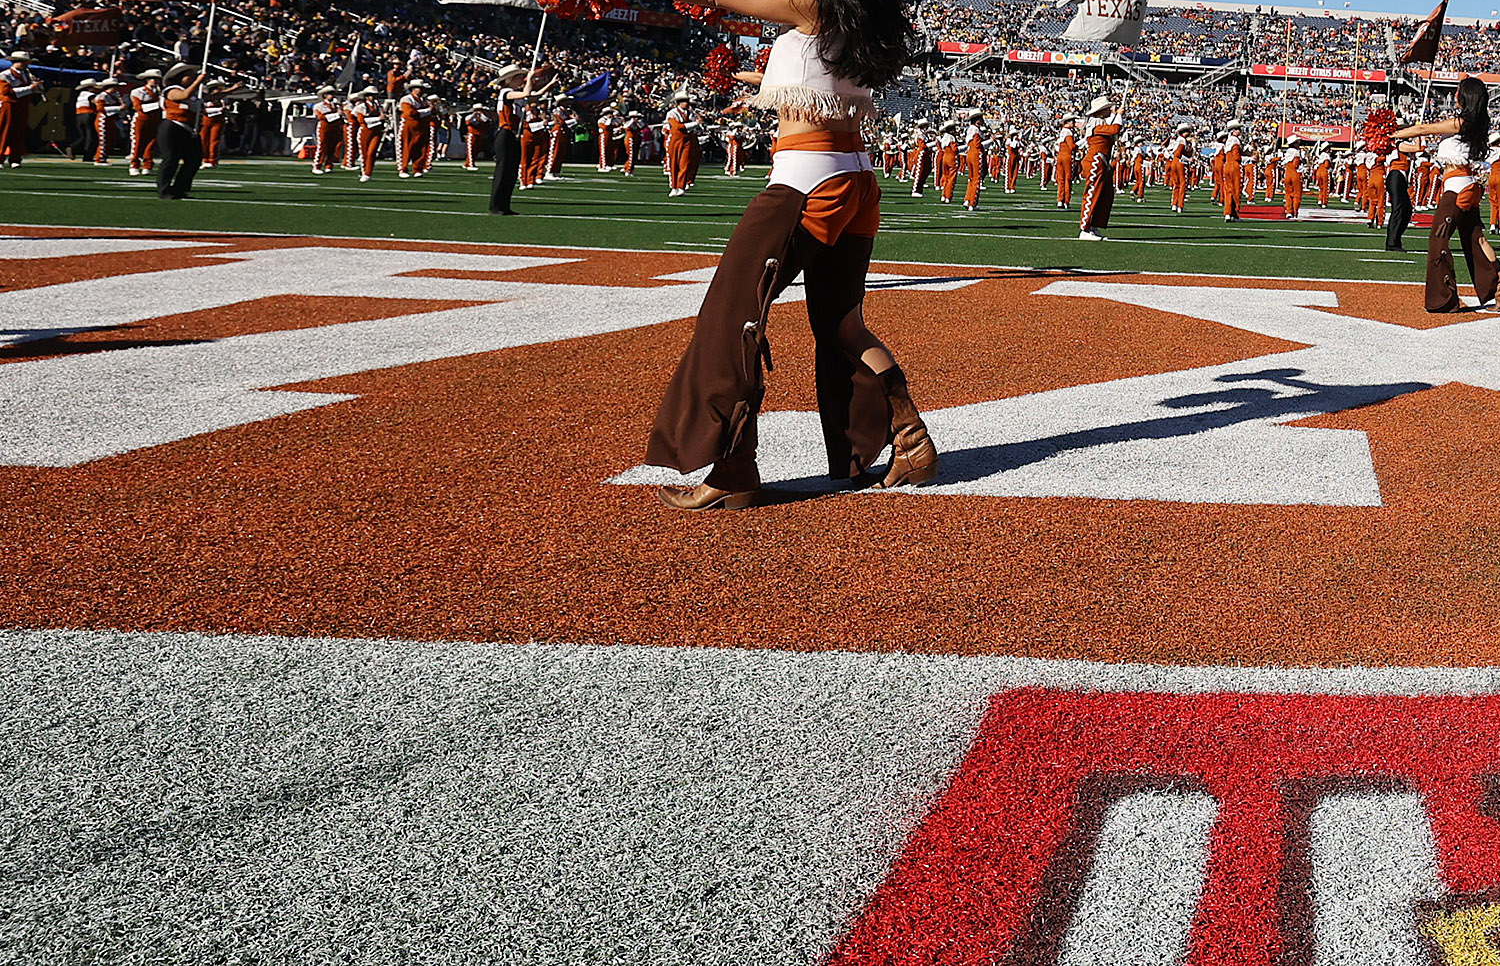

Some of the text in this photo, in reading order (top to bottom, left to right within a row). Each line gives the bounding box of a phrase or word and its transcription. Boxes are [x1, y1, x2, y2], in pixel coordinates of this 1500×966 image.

[764, 26, 776, 37] 25
[1310, 68, 1332, 77] CITRUS
[1333, 70, 1353, 78] BOWL
[1435, 71, 1459, 79] TEXAS
